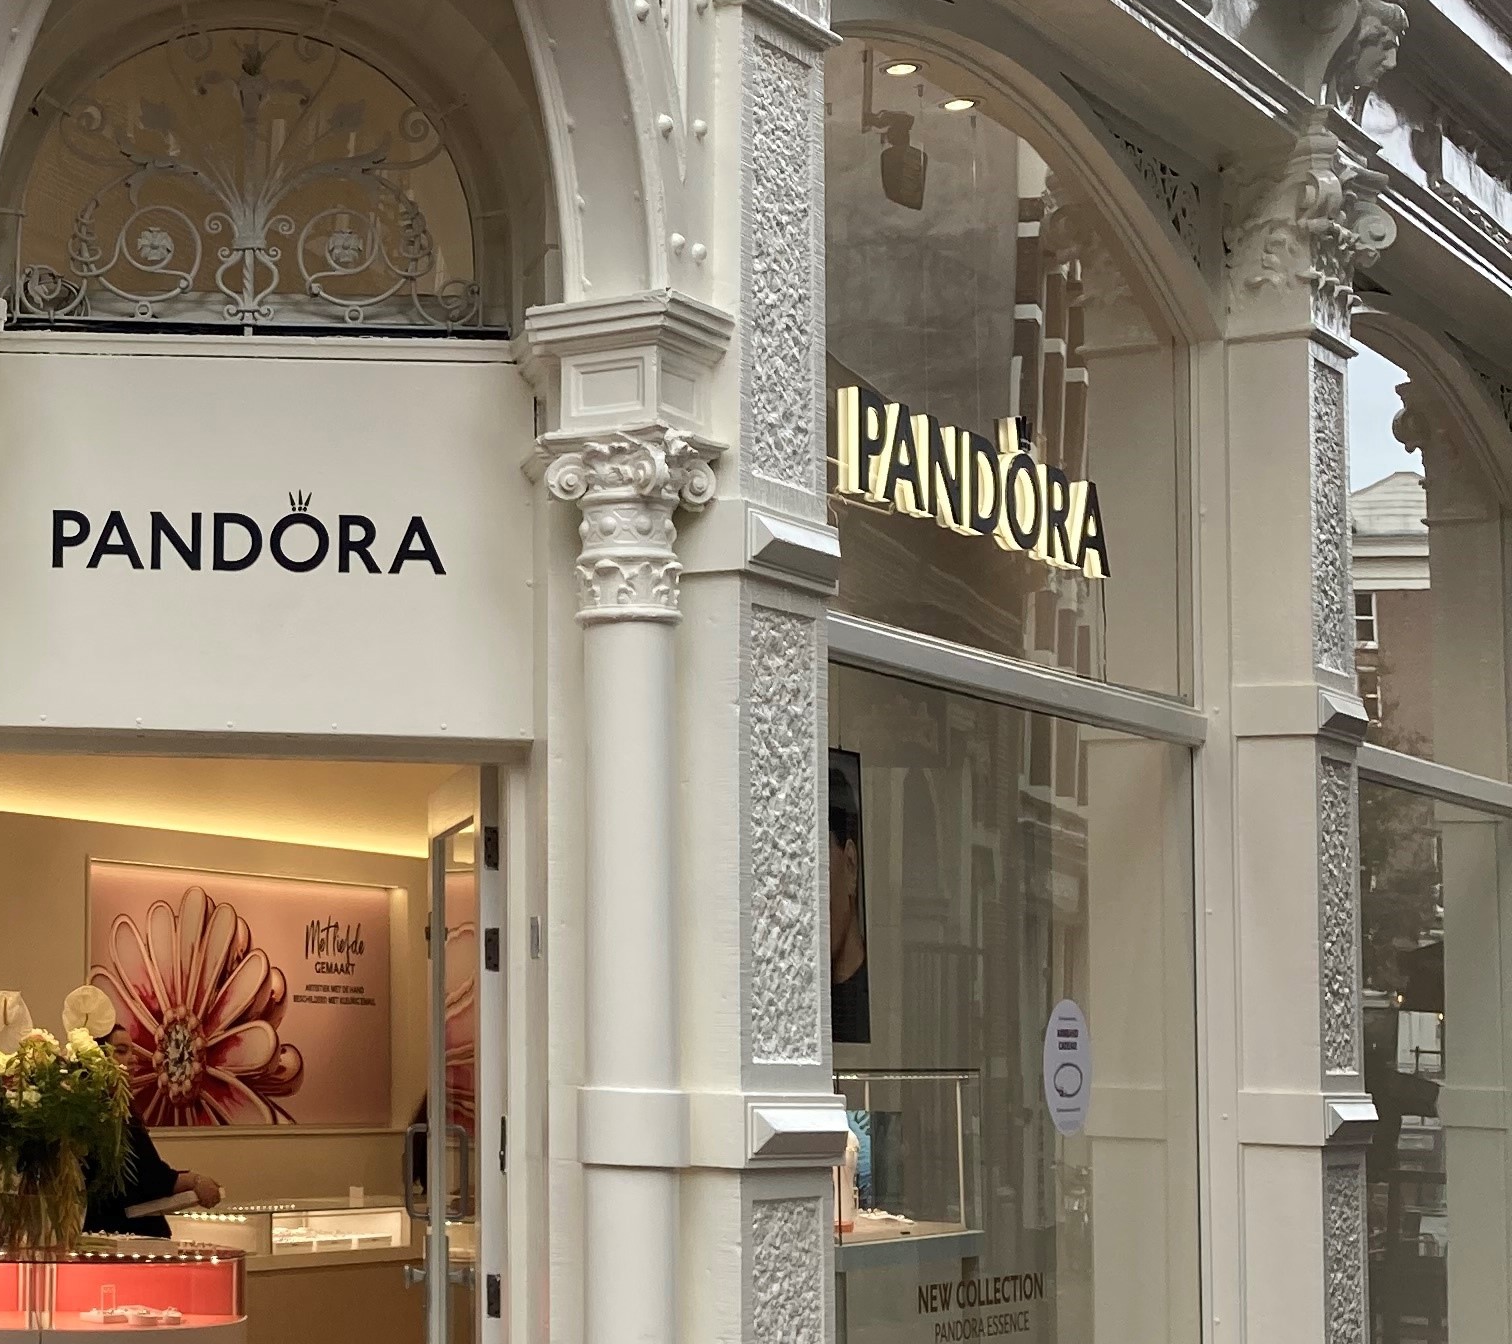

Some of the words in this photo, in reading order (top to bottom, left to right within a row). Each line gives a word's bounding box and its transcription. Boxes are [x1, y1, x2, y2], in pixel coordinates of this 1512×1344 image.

[840, 385, 1112, 579] PANDORA
[51, 506, 447, 576] PANDORA
[305, 915, 338, 960] Met
[333, 921, 365, 965] liefde
[314, 961, 356, 975] GEMAAKT
[918, 1282, 953, 1314] NEW
[956, 1272, 1044, 1309] COLLECTION
[934, 1318, 986, 1344] PANDORA
[987, 1311, 1030, 1337] ESSENCE
